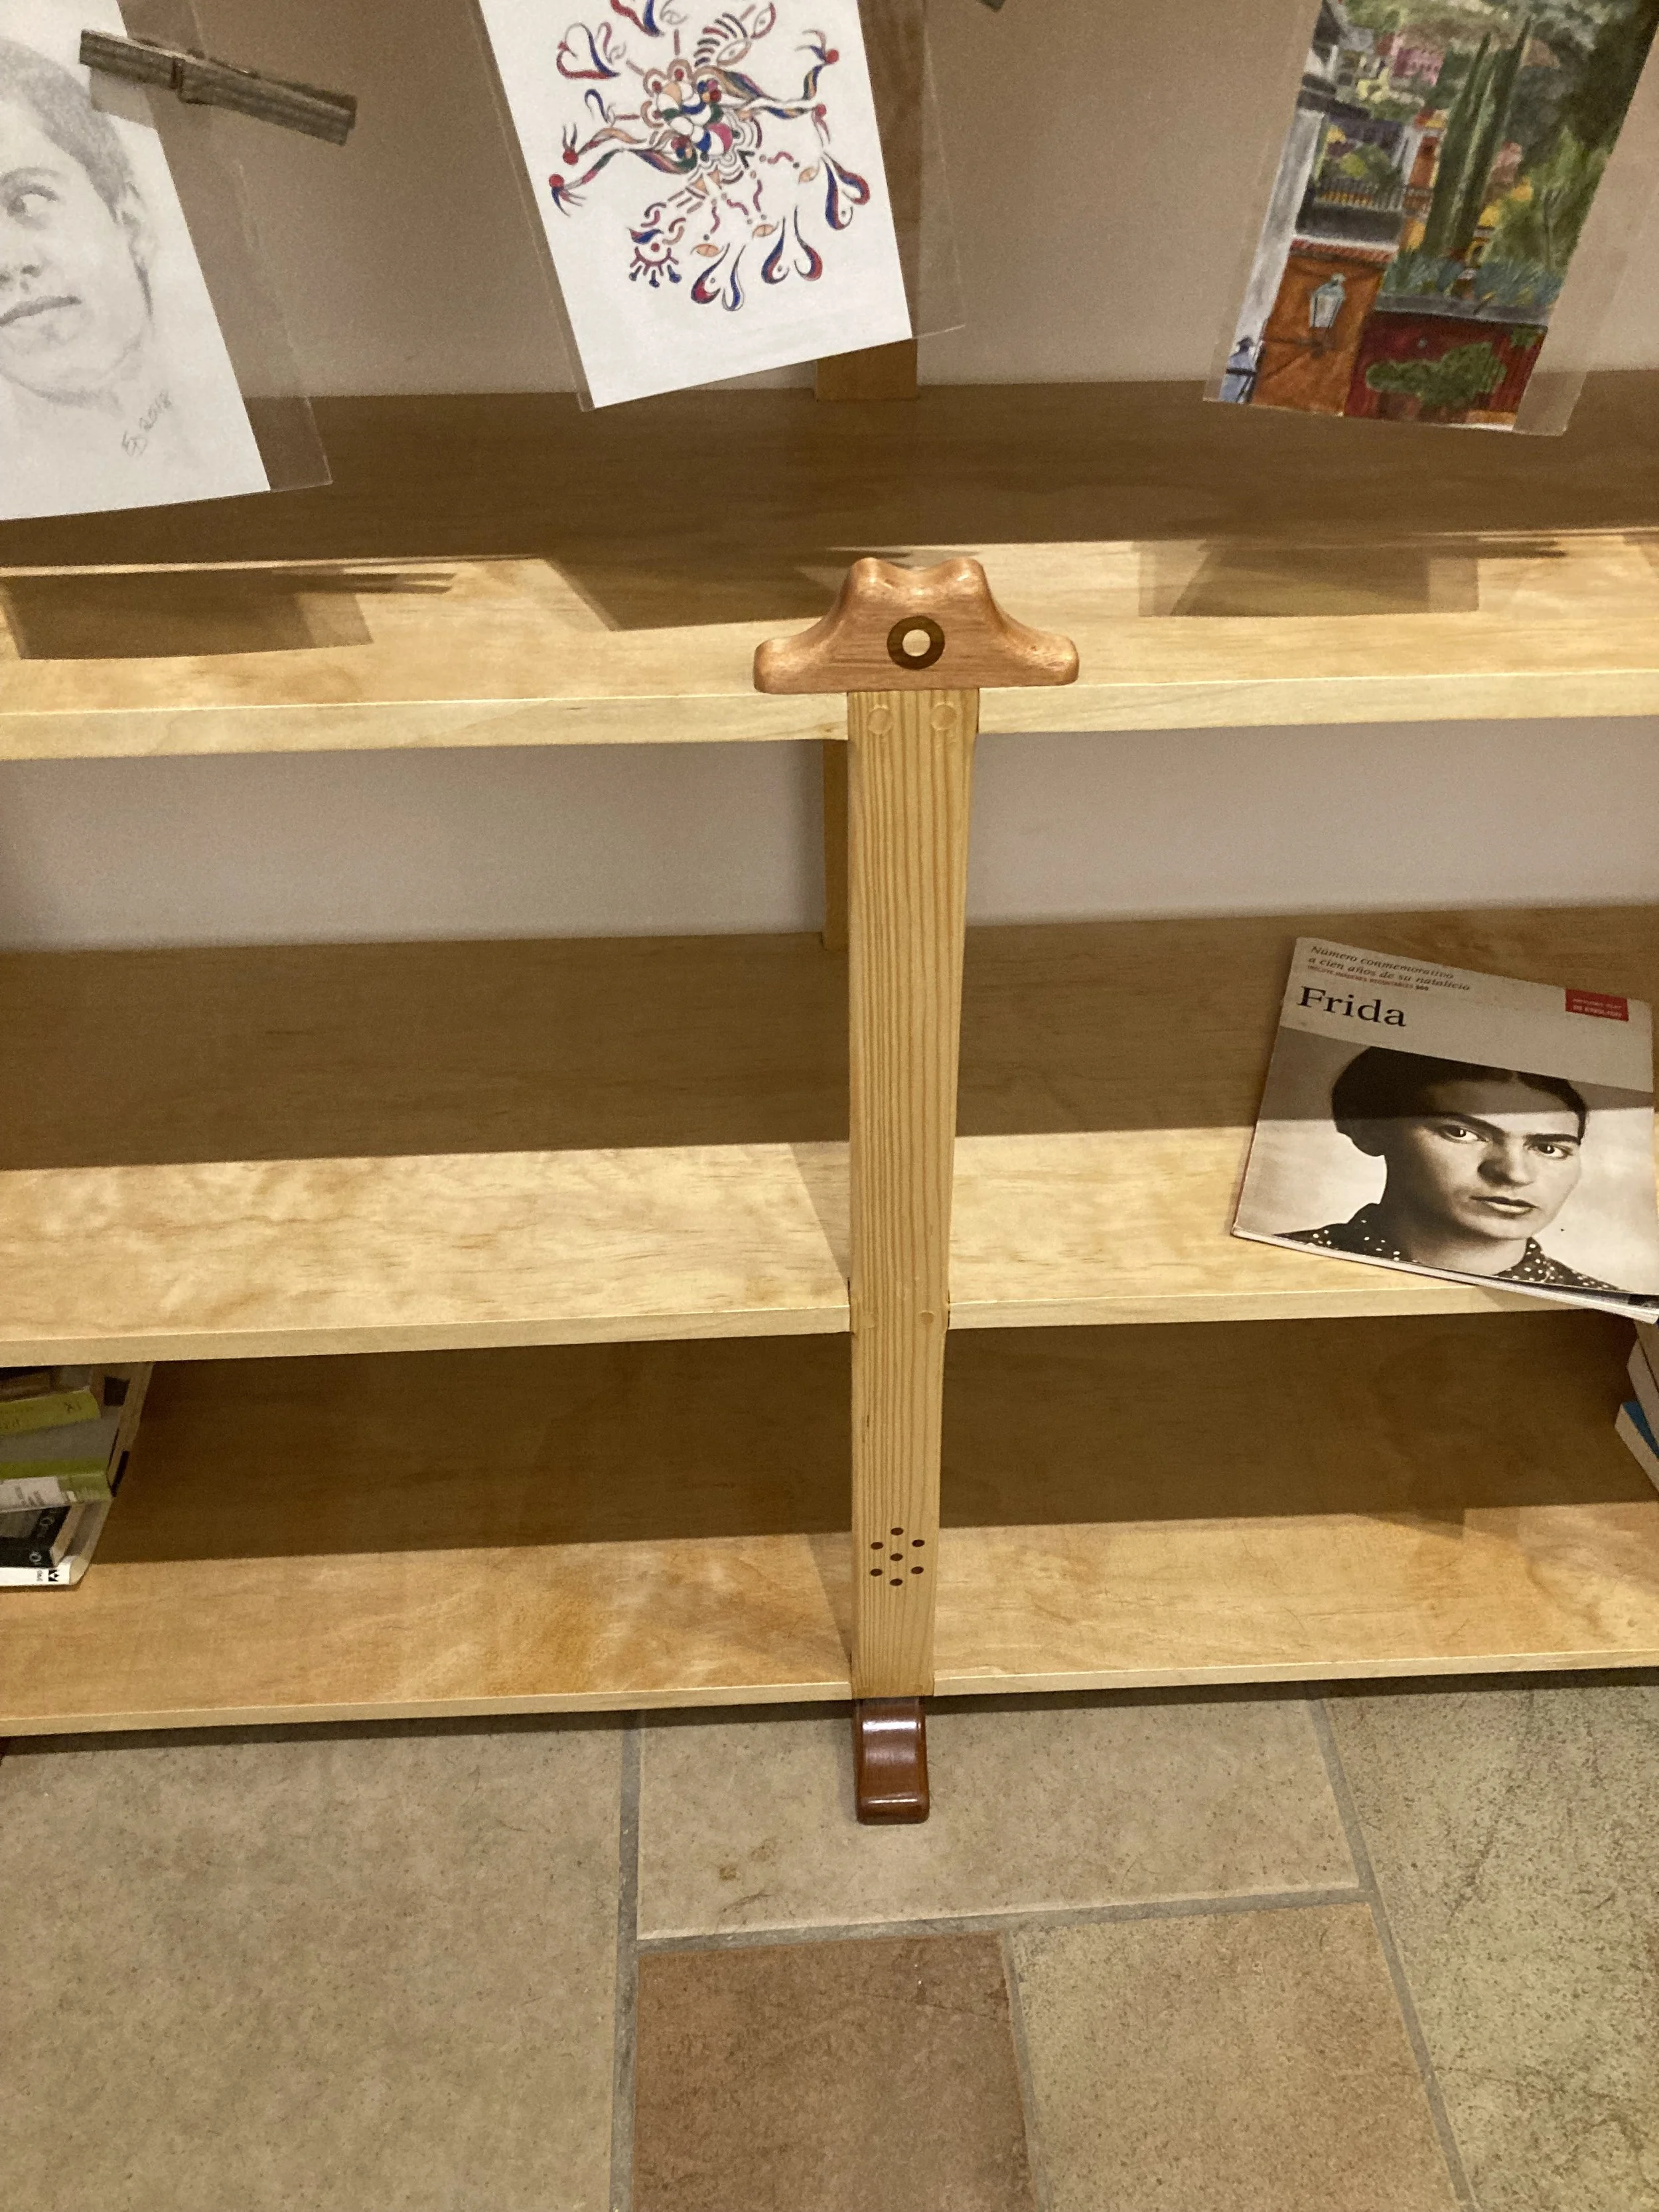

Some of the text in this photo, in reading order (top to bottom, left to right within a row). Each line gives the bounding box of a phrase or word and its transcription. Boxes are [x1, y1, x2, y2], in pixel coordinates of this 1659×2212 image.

[1319, 960, 1344, 970] cien
[1348, 966, 1377, 976] años
[1415, 977, 1471, 991] natalicio
[1360, 958, 1455, 979] conmemorativo
[1296, 985, 1407, 1027] Frida
